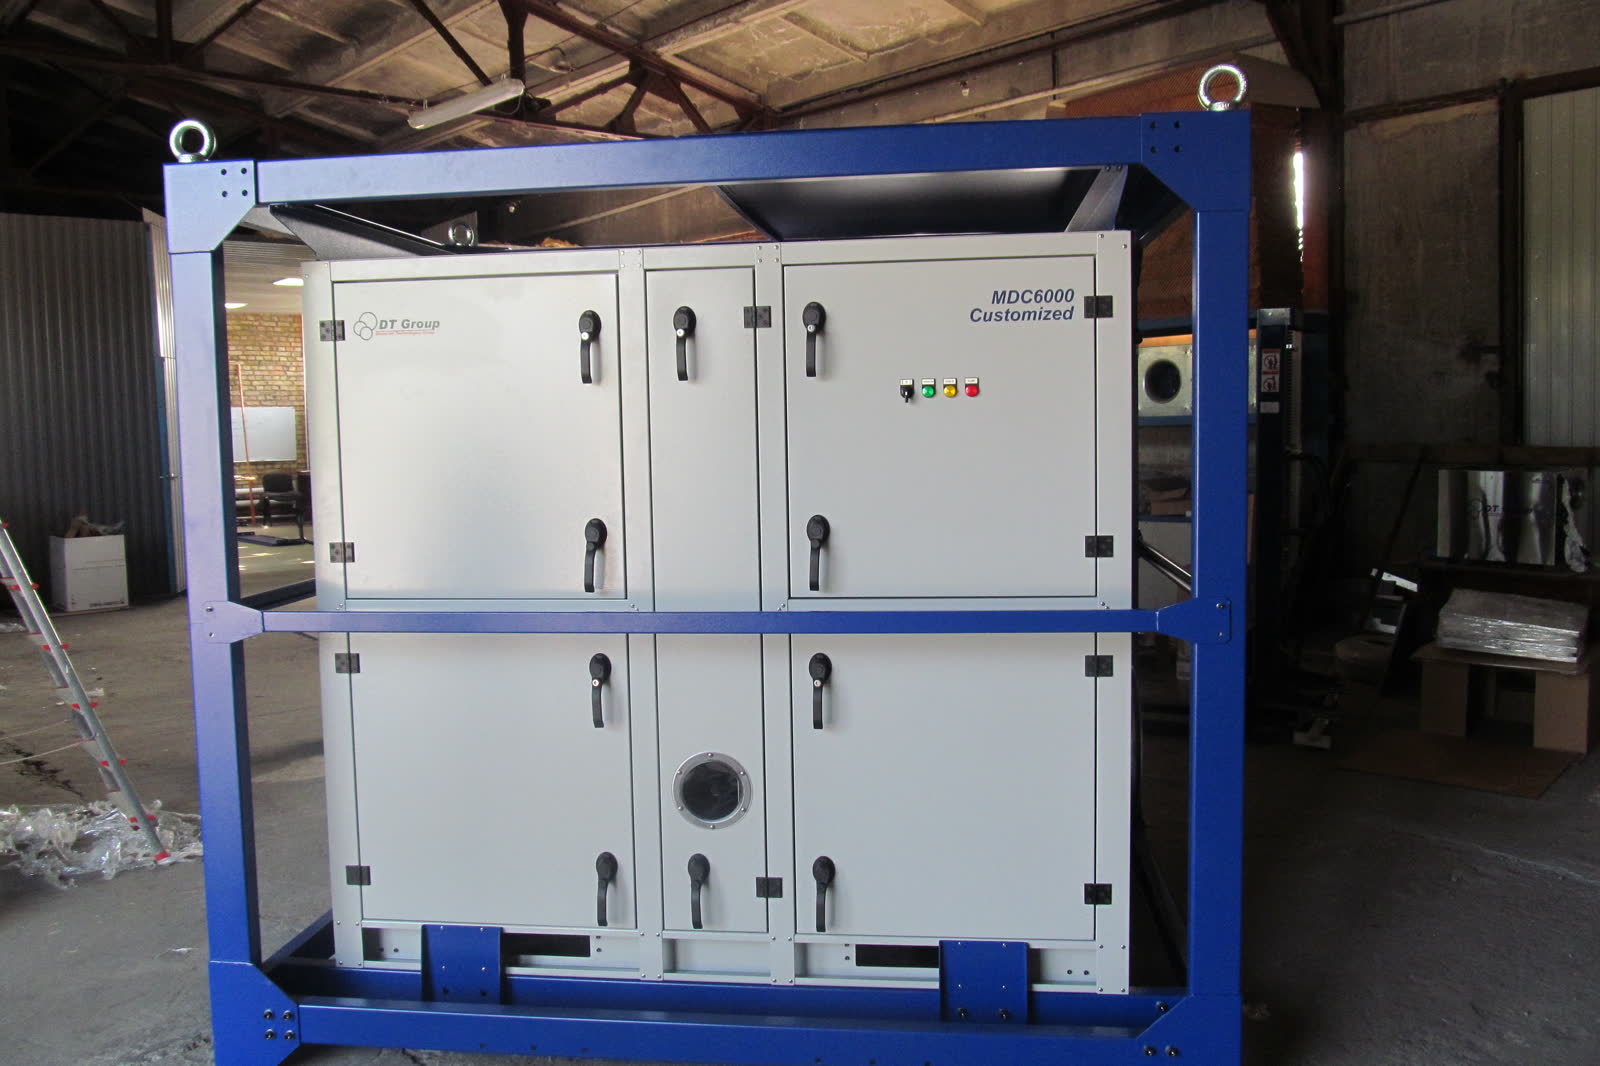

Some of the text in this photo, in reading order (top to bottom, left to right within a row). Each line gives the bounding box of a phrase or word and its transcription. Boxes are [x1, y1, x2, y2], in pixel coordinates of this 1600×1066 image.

[992, 288, 1075, 304] MDC6000
[969, 306, 1075, 322] Customized
[379, 319, 440, 330] DT Group
